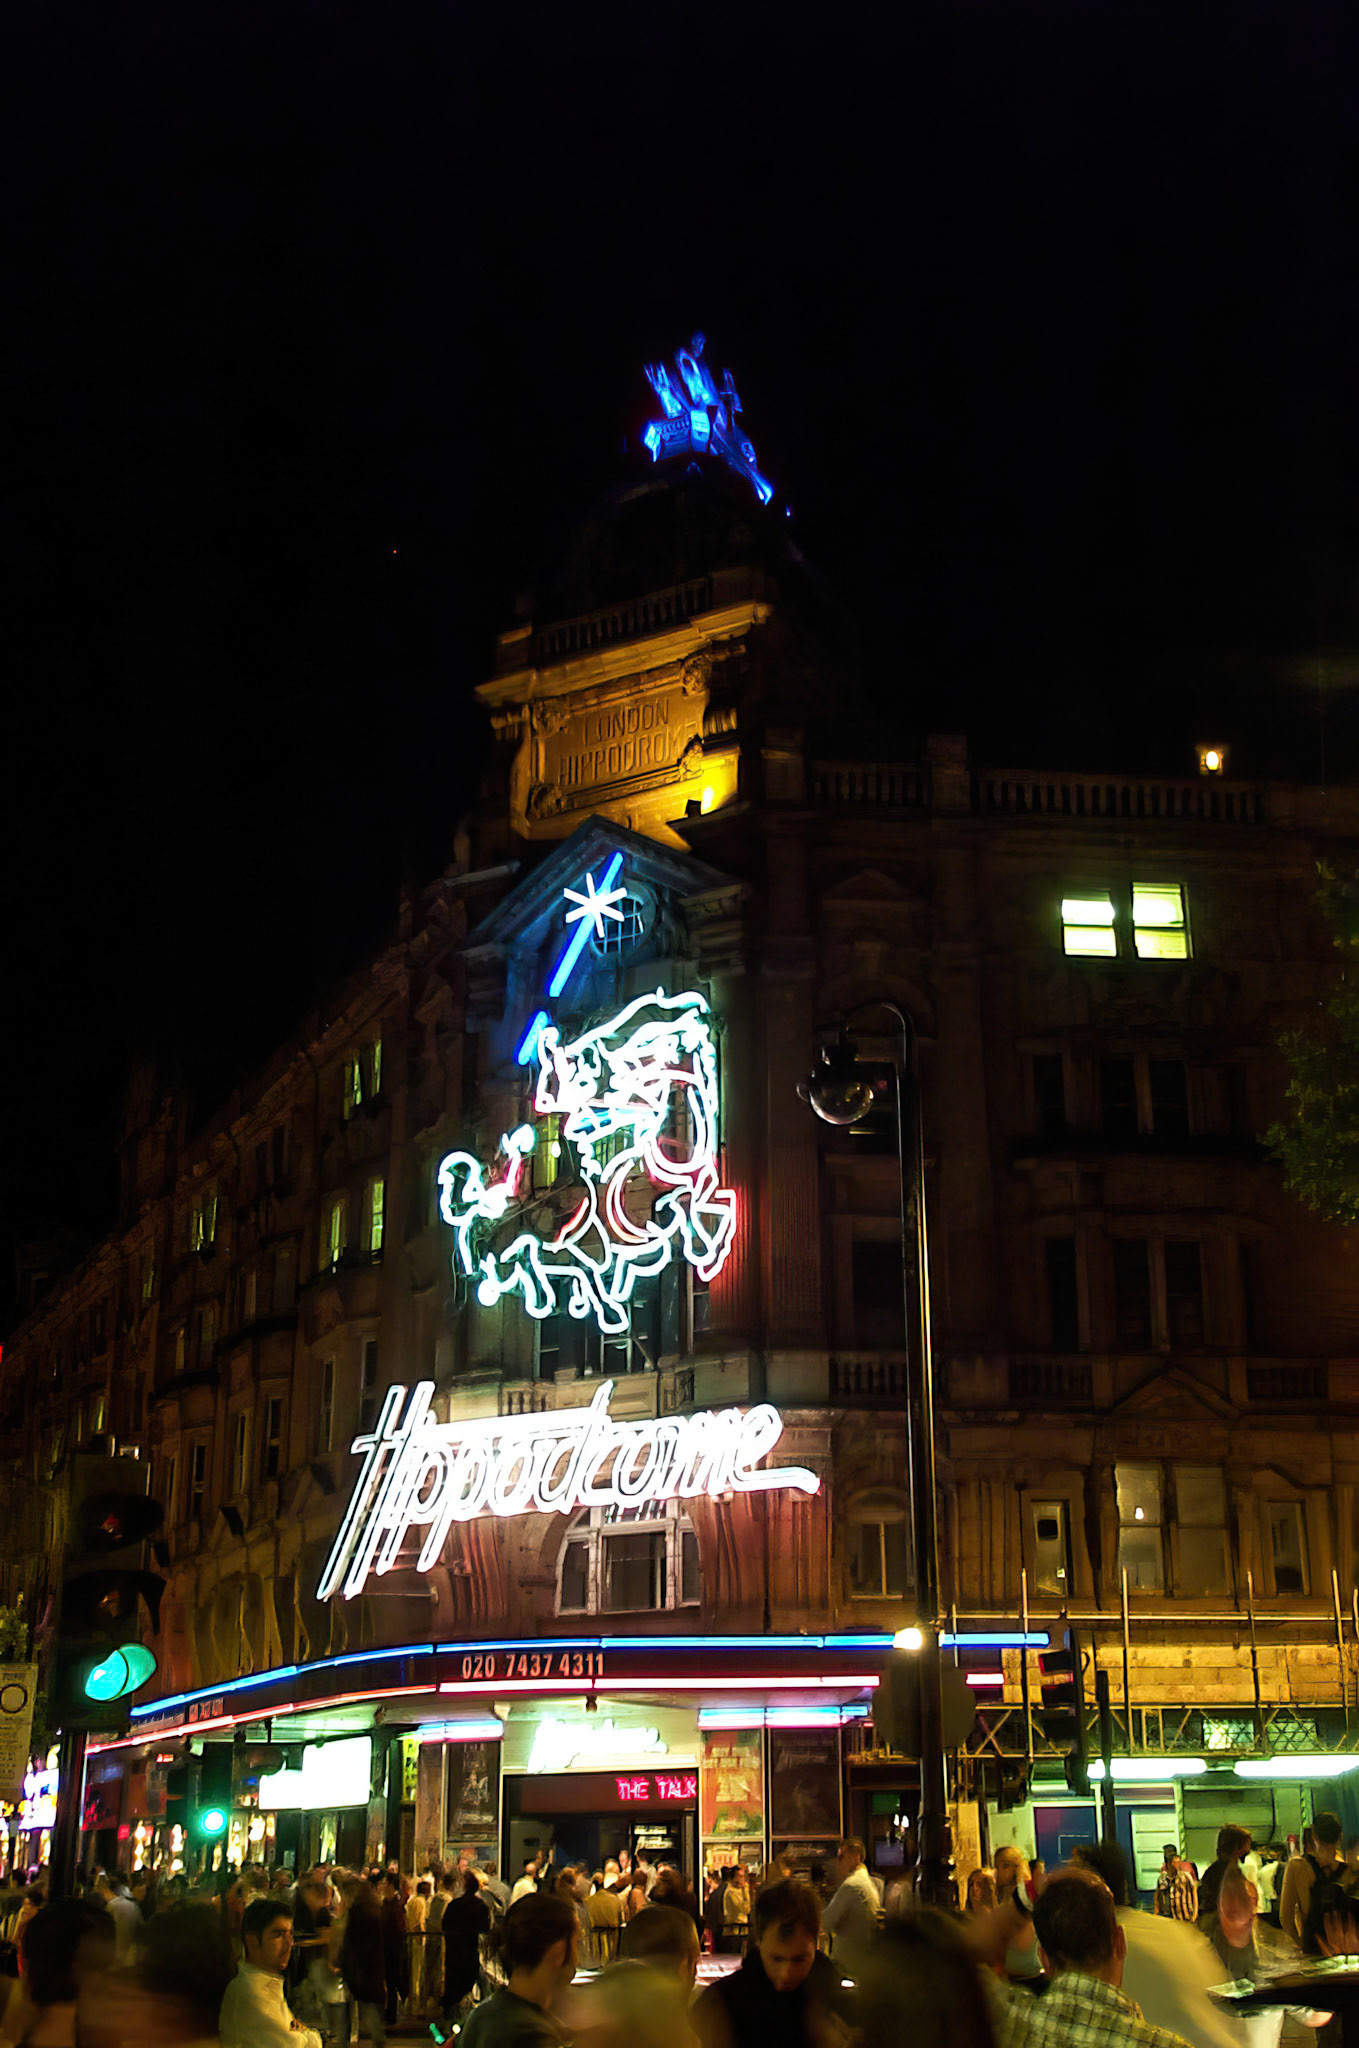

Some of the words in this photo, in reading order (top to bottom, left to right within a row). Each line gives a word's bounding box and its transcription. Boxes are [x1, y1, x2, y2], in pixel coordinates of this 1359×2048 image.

[583, 697, 670, 746] LONDON
[462, 1655, 496, 1680] 020
[506, 1653, 553, 1678] 7437
[559, 1652, 605, 1677] 4311
[616, 1776, 650, 1801] THE
[655, 1775, 697, 1800] TALK
